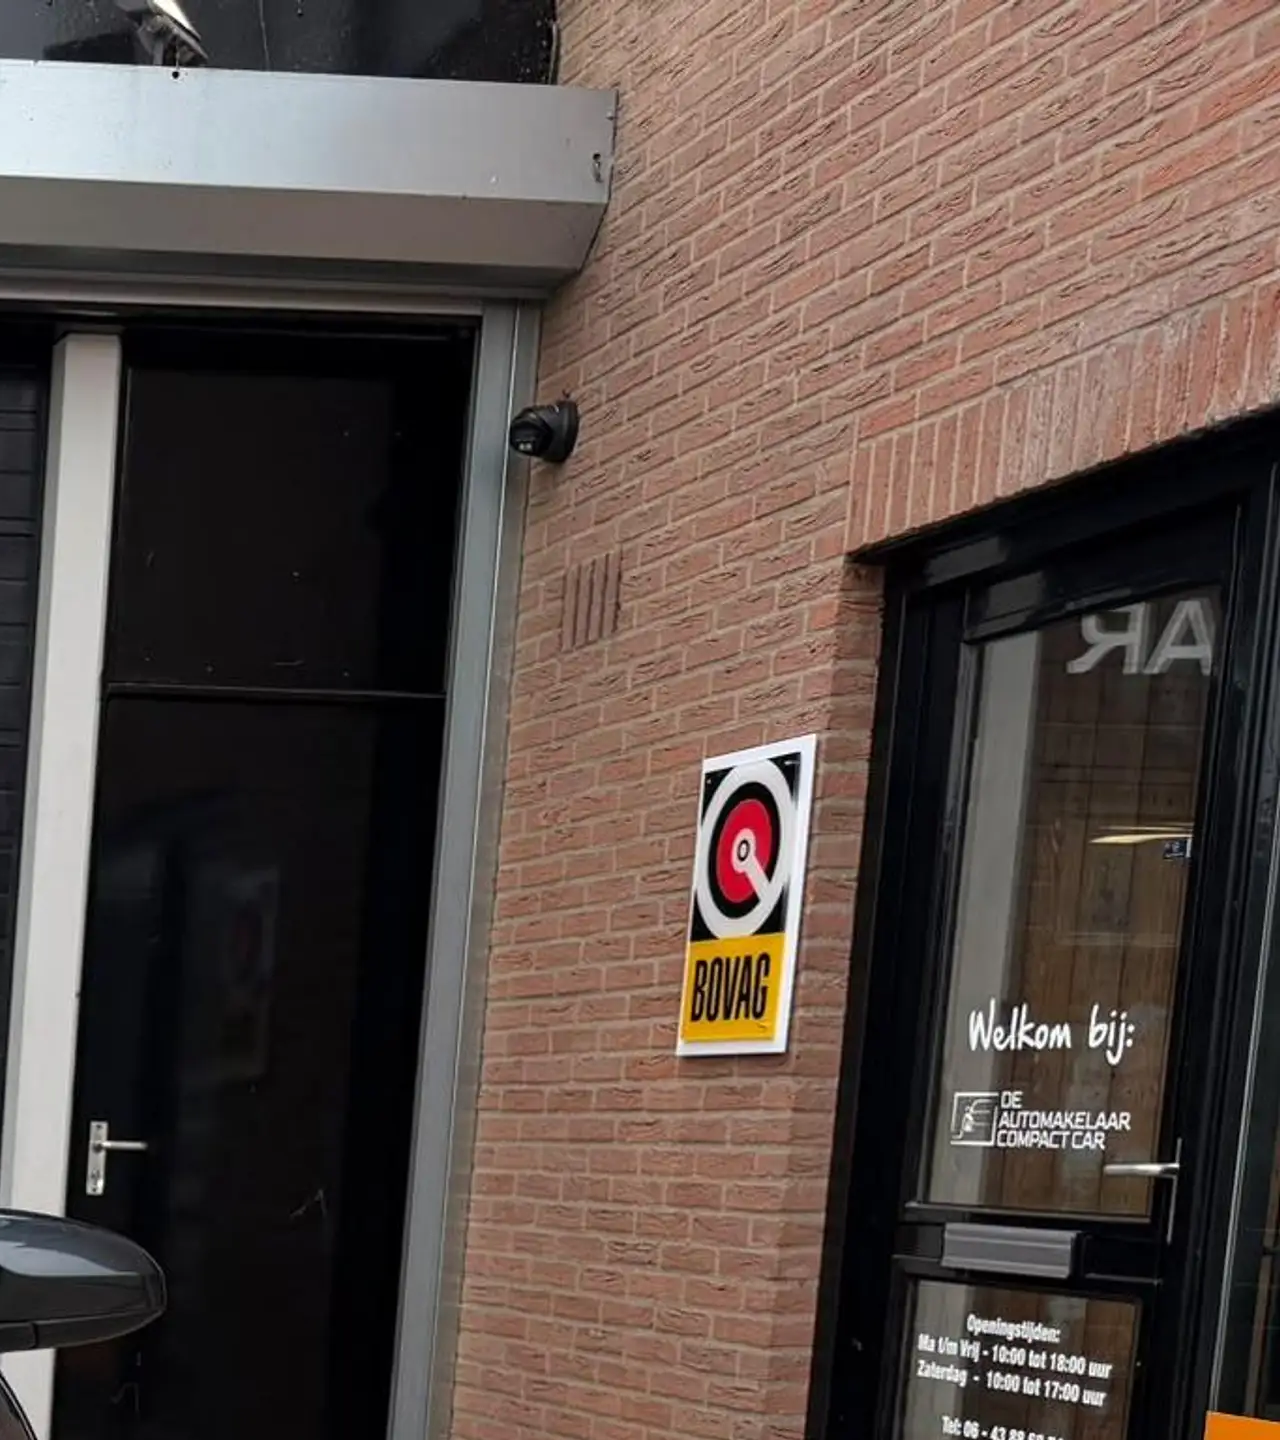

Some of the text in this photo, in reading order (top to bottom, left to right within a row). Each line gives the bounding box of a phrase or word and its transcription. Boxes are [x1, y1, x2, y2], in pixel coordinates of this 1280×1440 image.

[690, 952, 771, 1022] BOVAG
[969, 998, 1135, 1065] Welkom bij:
[1001, 1091, 1023, 1109] DE
[998, 1111, 1131, 1130] AUTOMAKELAAR
[996, 1129, 1105, 1150] COMPACT CAR
[966, 1313, 1060, 1344] Openingstijden:
[918, 1333, 935, 1352] Ma
[992, 1344, 1026, 1366] 10:00
[1029, 1350, 1046, 1369] tot
[1050, 1352, 1086, 1375] 18:00
[1088, 1361, 1113, 1378] uur
[917, 1360, 968, 1388] Zaterdag
[986, 1370, 1020, 1392] 10:00
[1023, 1376, 1040, 1396] tot
[1044, 1380, 1080, 1403] 17:00
[1082, 1389, 1107, 1407] uur
[963, 1420, 979, 1439] 06
